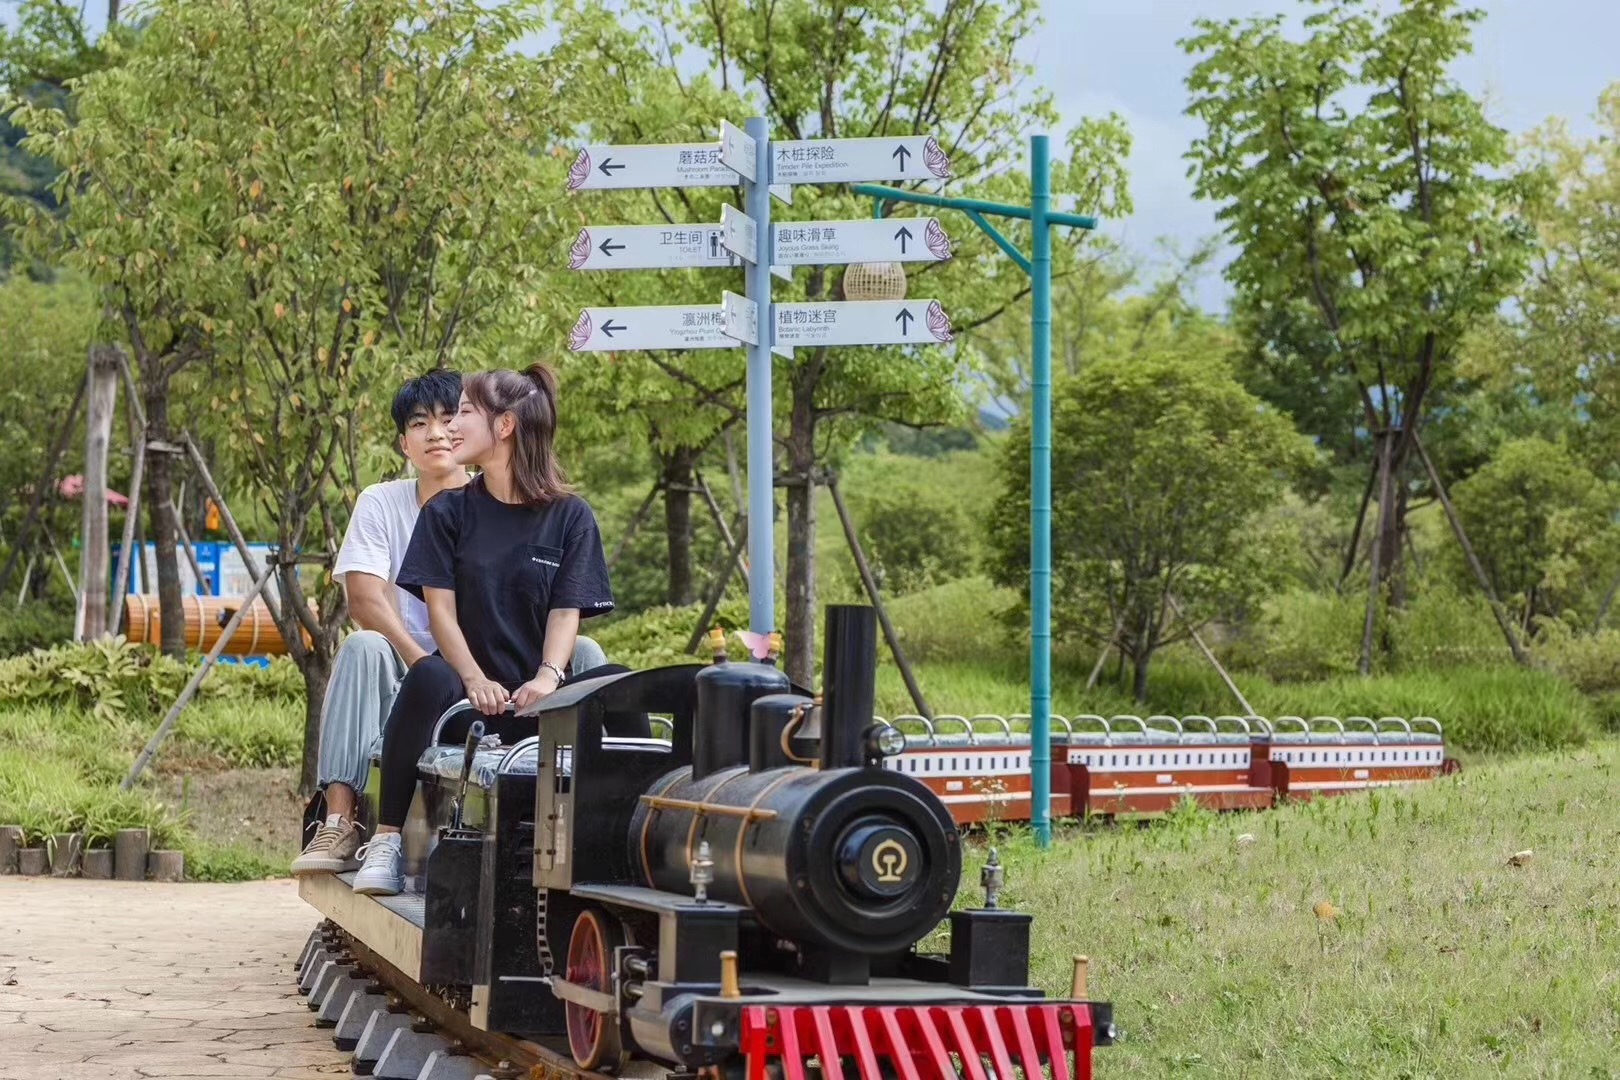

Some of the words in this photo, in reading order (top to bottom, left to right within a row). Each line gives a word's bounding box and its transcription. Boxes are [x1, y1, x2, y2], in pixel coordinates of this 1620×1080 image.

[678, 149, 719, 165] 蘑菇乐
[776, 145, 835, 162] 木桩探险
[815, 161, 848, 170] Expedition
[659, 231, 702, 245] 卫生间
[778, 227, 836, 243] 趣味滑草
[778, 309, 837, 324] 植物迷宫
